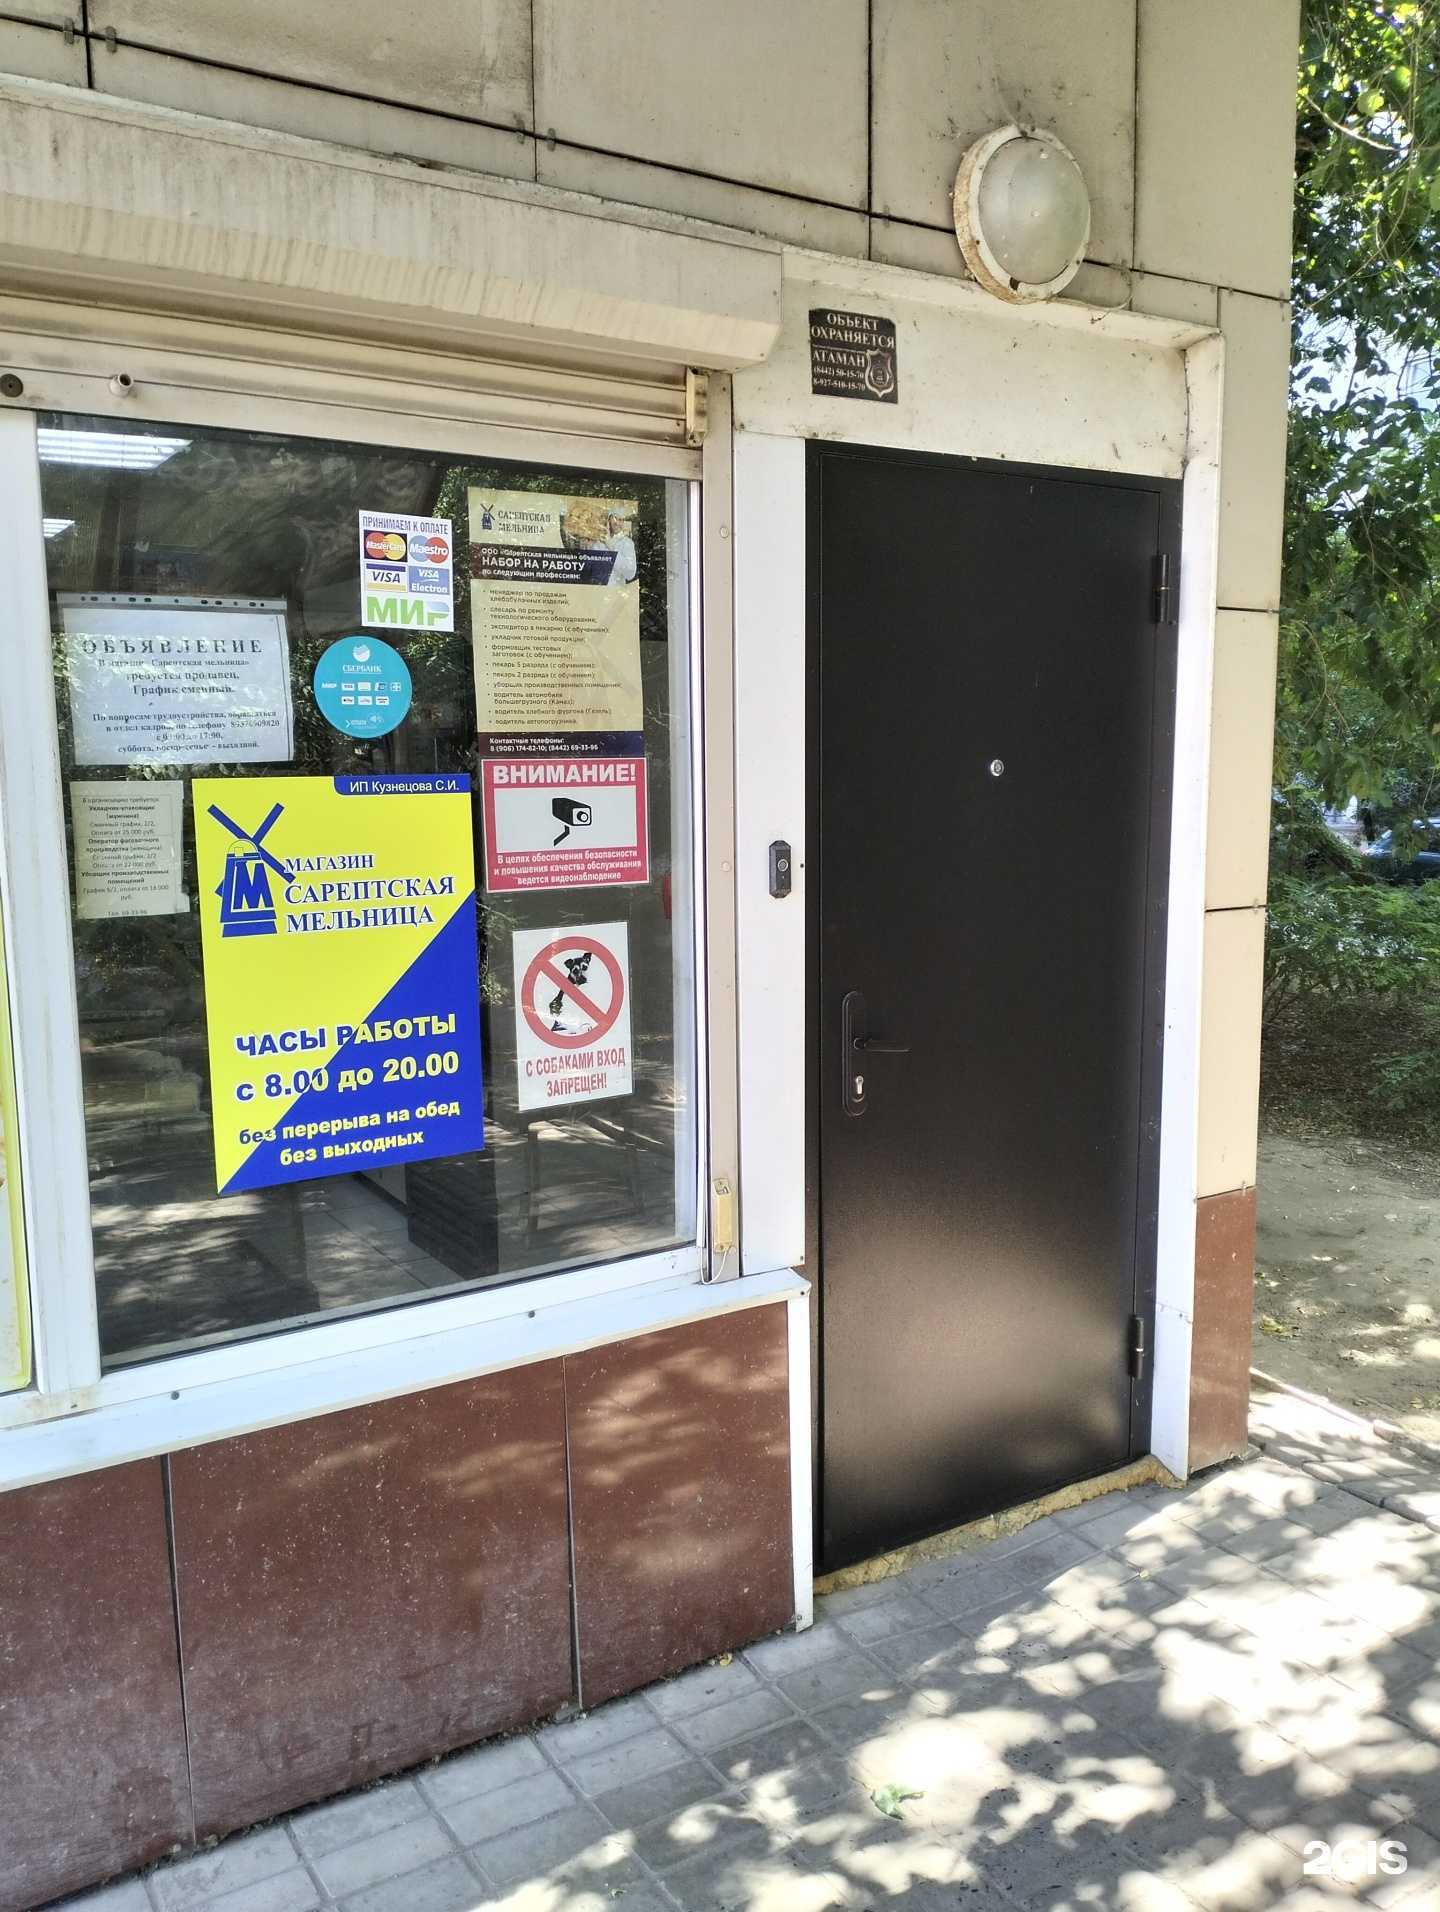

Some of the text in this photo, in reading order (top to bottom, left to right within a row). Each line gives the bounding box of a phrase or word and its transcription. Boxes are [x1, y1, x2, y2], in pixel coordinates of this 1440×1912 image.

[827, 313, 879, 331] ОБЪЕКТ
[812, 326, 894, 348] ОХРАНЯЕТСЯ
[812, 350, 865, 367] АТАМАН
[363, 516, 448, 534] ПРИНИМАЕМ К ОПЛАТЕ
[410, 543, 448, 555] Maestro
[482, 556, 585, 571] НАБОР НА РАБОТУ
[372, 571, 400, 583] VISA
[419, 569, 439, 578] VISA
[494, 569, 534, 577] следующим
[536, 571, 580, 580] профессиям:
[412, 584, 447, 593] Electron
[367, 597, 449, 626] МИР
[82, 639, 263, 654] ОБЪЯВЛЕНИЕ
[134, 684, 178, 695] График
[93, 713, 106, 721] По
[109, 713, 150, 723] вопросам
[493, 764, 636, 784] ВНИМАНИЕ!
[351, 780, 459, 793] ИП Кузнецова С.И.
[286, 854, 373, 872] МАГАЗИН
[498, 850, 637, 864] В целях обеспечения безопасности
[502, 866, 548, 876] повышения
[550, 864, 585, 872] качества
[587, 860, 641, 872] обслуживания
[518, 872, 621, 886] ведется видеонаблюдение
[285, 877, 454, 904] САРЕПТСКАЯ
[287, 906, 433, 932] МЕЛЬНИЦА
[236, 1014, 456, 1056] ЧАСЫ РАБОТЫ
[526, 1048, 625, 1076] С СОБАКАМИ ВХОД
[236, 1052, 459, 1100] с 8.00 до 20.00
[547, 1073, 607, 1096] ЗАПРЕЩЕН!
[240, 1101, 460, 1144] без перерыва на обед
[280, 1131, 424, 1165] без выходных
